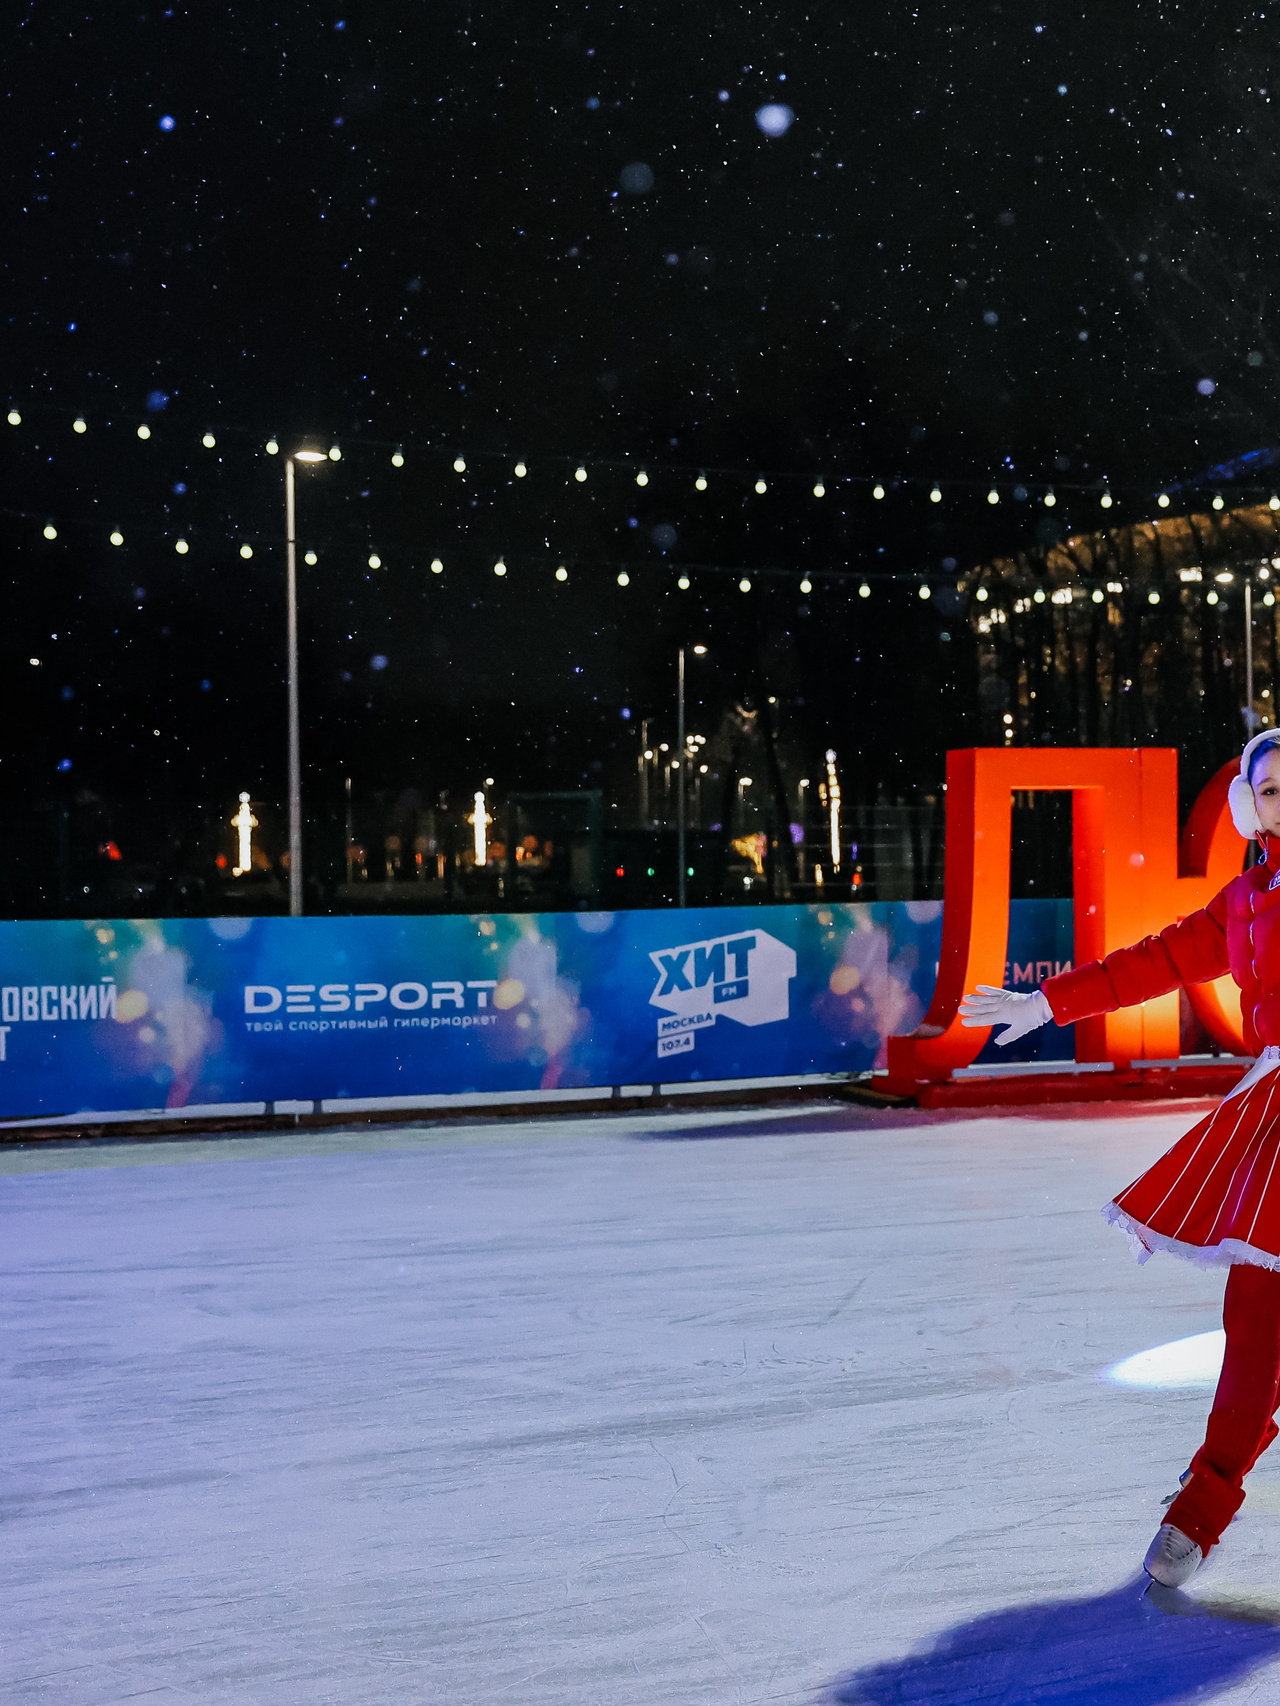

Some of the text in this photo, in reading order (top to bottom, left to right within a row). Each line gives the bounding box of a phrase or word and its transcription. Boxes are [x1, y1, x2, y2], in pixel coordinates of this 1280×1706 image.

[658, 935, 756, 997] ХИТ
[244, 980, 497, 1014] DESPORT
[721, 985, 737, 997] FM
[245, 1014, 497, 1033] твой спортивный гипермаркет
[661, 1012, 713, 1031] МОСКВА
[661, 1036, 691, 1051] 107.4
